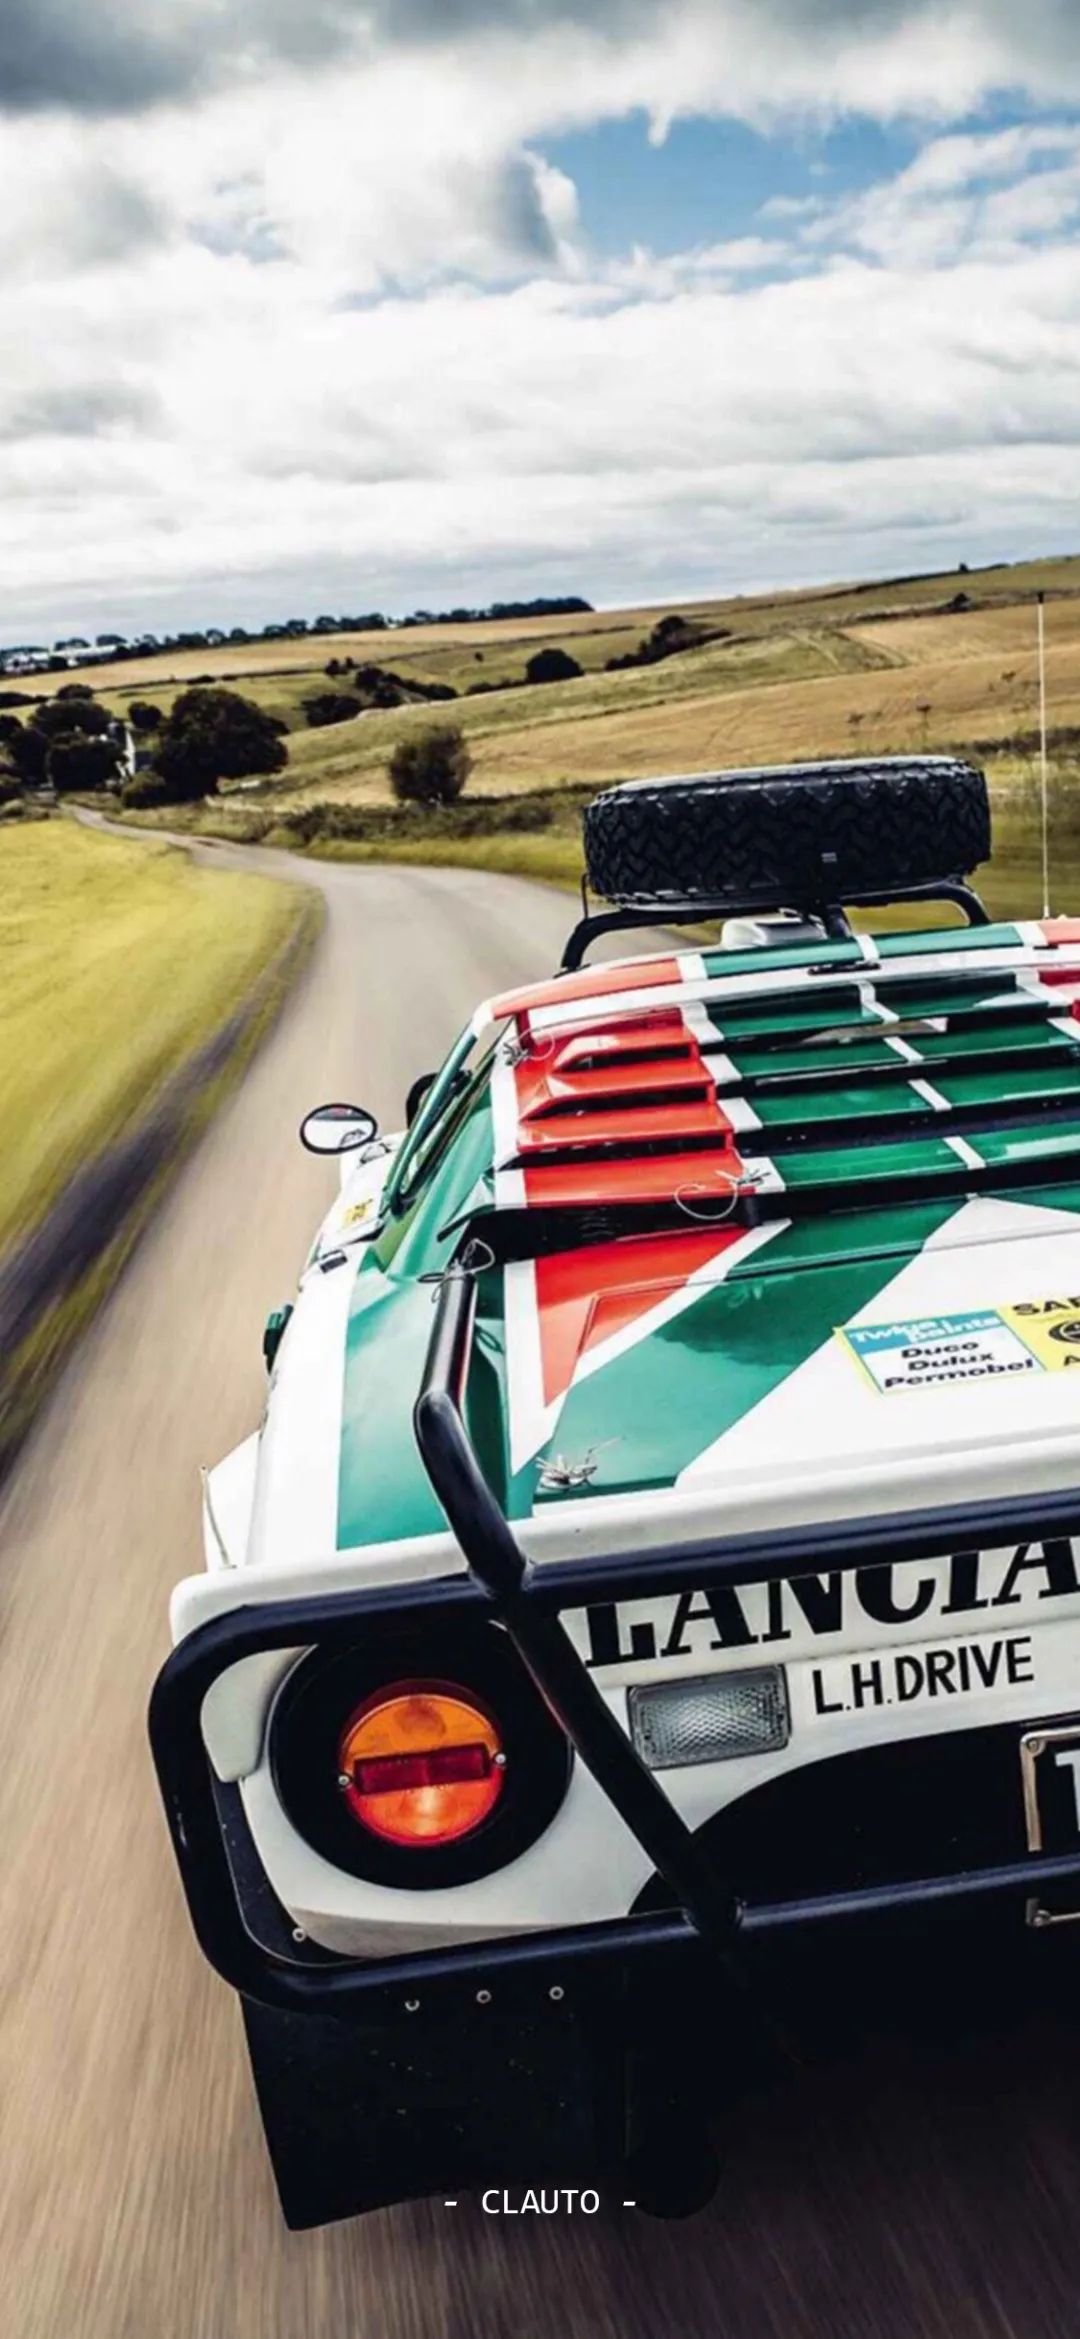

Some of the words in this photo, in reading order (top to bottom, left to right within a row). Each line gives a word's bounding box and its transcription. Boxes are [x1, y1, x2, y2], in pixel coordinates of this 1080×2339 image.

[901, 1341, 979, 1358] Duco
[908, 1352, 994, 1371] Dulux
[885, 1359, 1033, 1388] Permobel
[585, 1537, 1080, 1668] LANCIA
